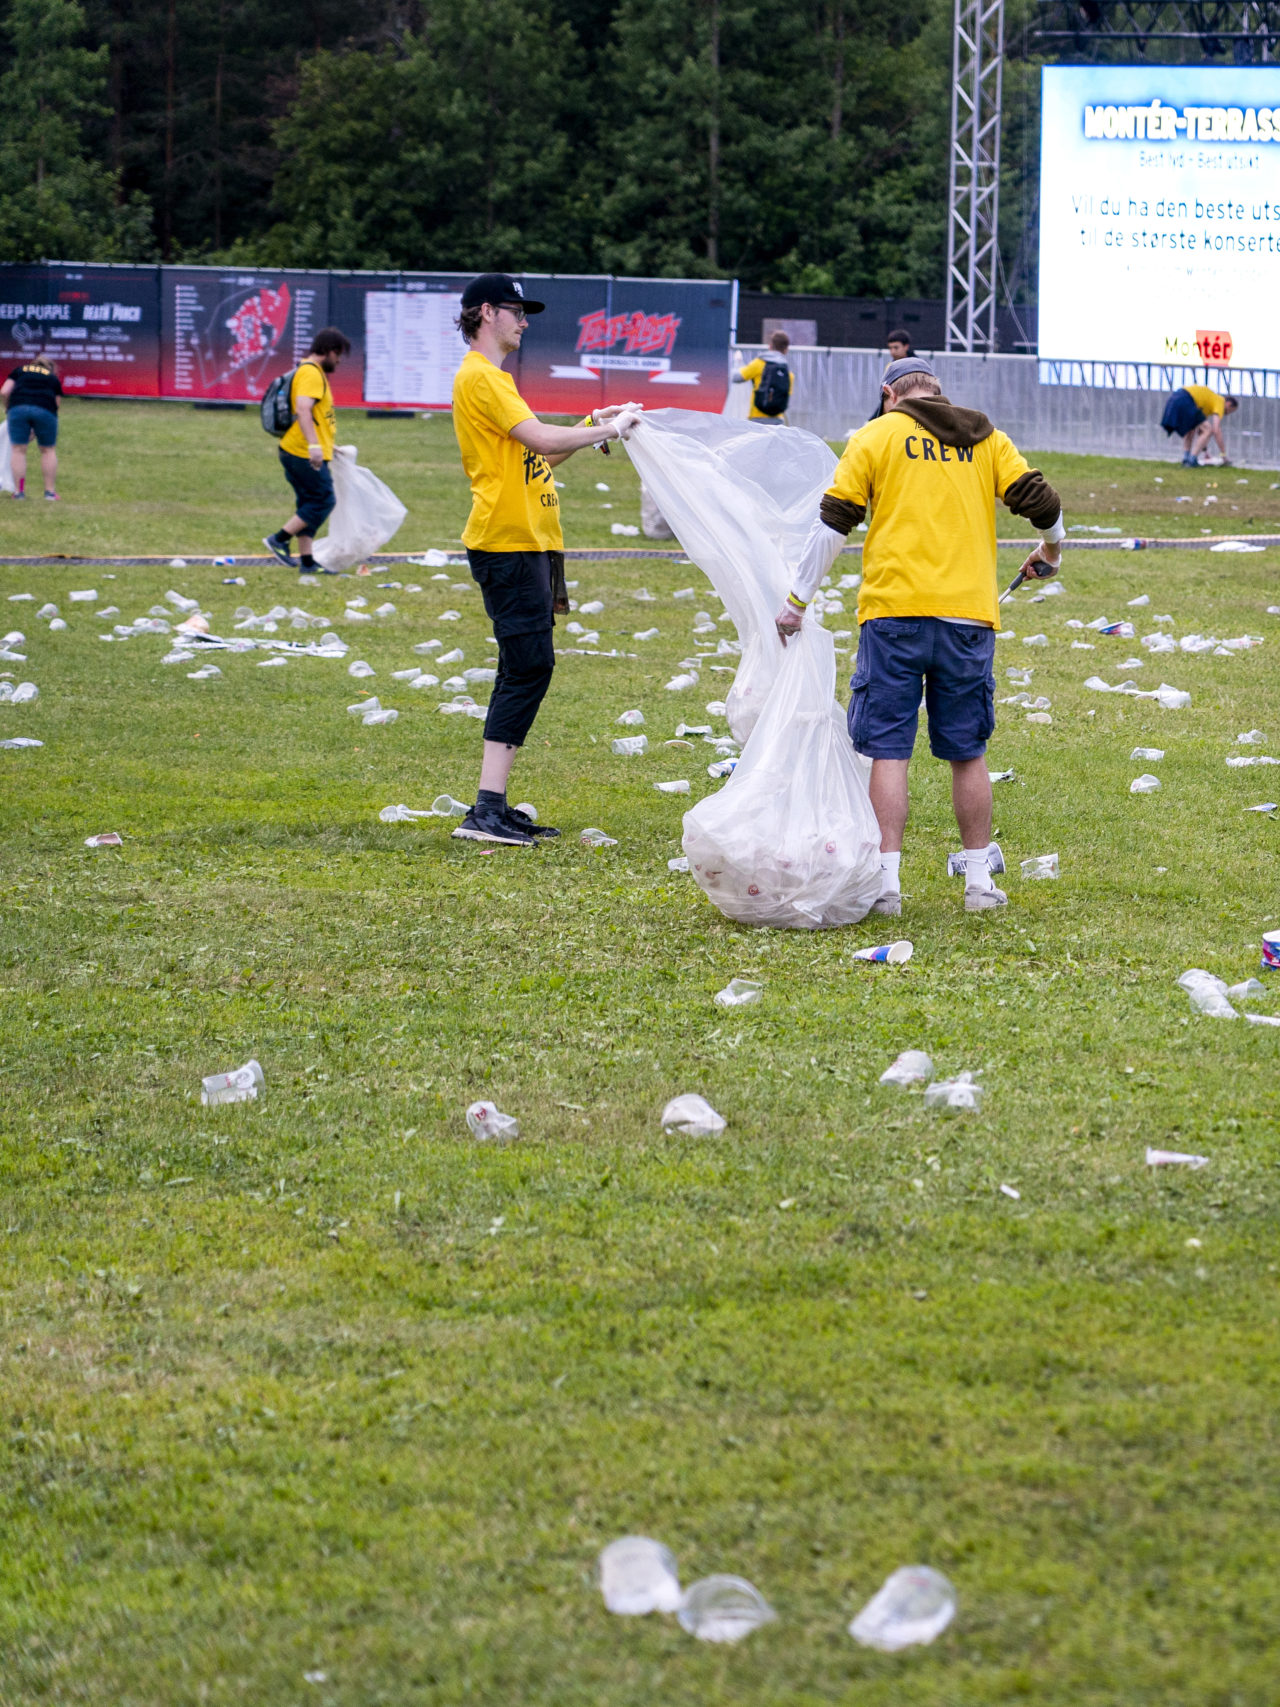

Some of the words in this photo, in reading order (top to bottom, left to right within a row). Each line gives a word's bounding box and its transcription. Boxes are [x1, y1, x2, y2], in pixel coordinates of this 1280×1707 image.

[1072, 195, 1093, 214] Vil
[1100, 197, 1121, 216] du
[1128, 197, 1149, 217] ha
[1156, 198, 1188, 218] den
[1195, 198, 1245, 220] beste
[1104, 228, 1124, 247] de
[1164, 335, 1231, 359] Montér
[905, 435, 974, 463] CREW
